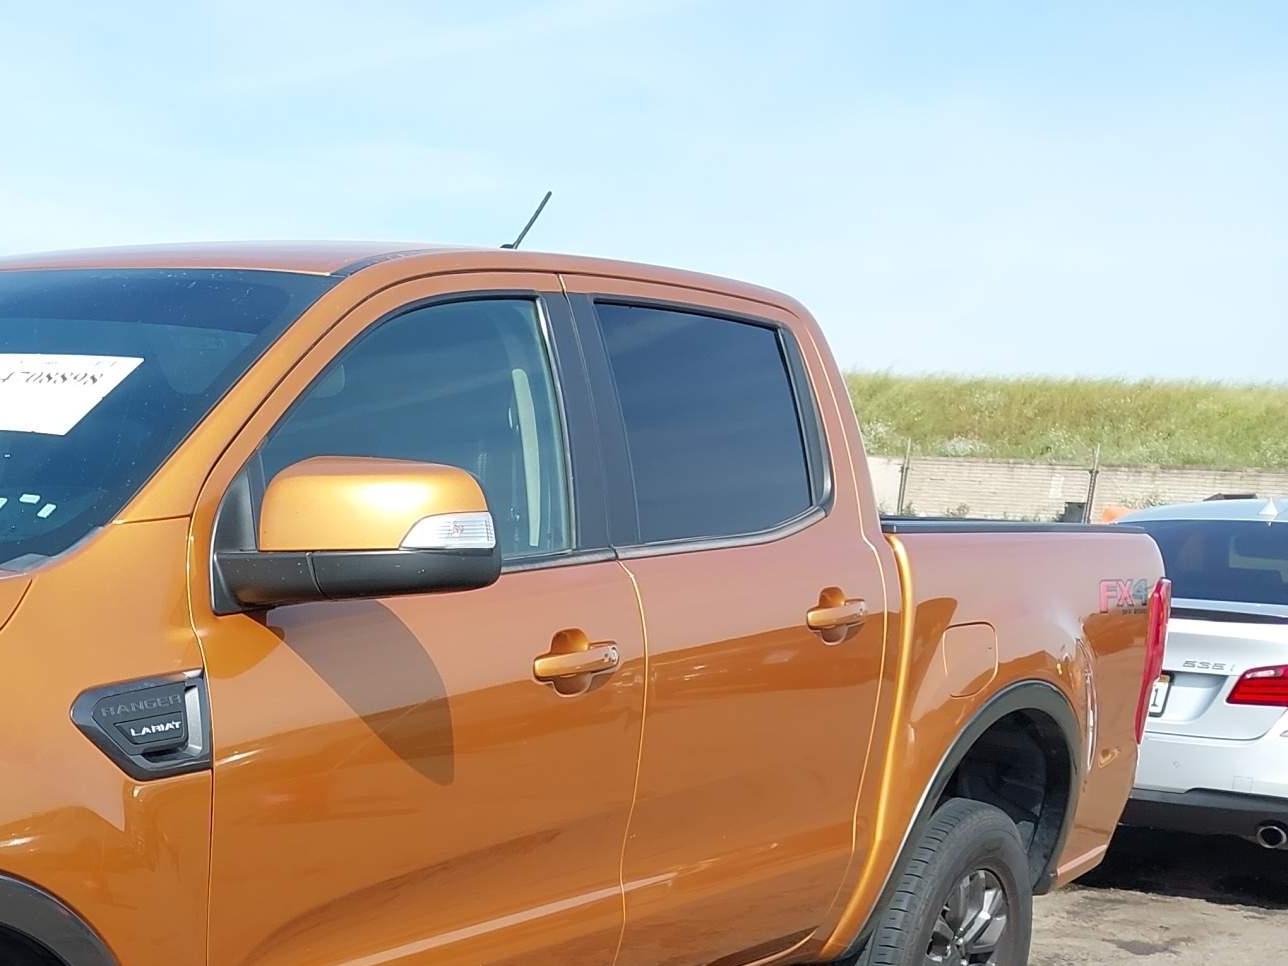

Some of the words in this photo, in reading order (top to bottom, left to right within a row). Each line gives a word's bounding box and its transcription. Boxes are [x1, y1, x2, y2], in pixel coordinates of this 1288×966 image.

[1099, 579, 1147, 613] FX4
[101, 694, 182, 716] RANGER
[130, 720, 181, 737] LARIAT
